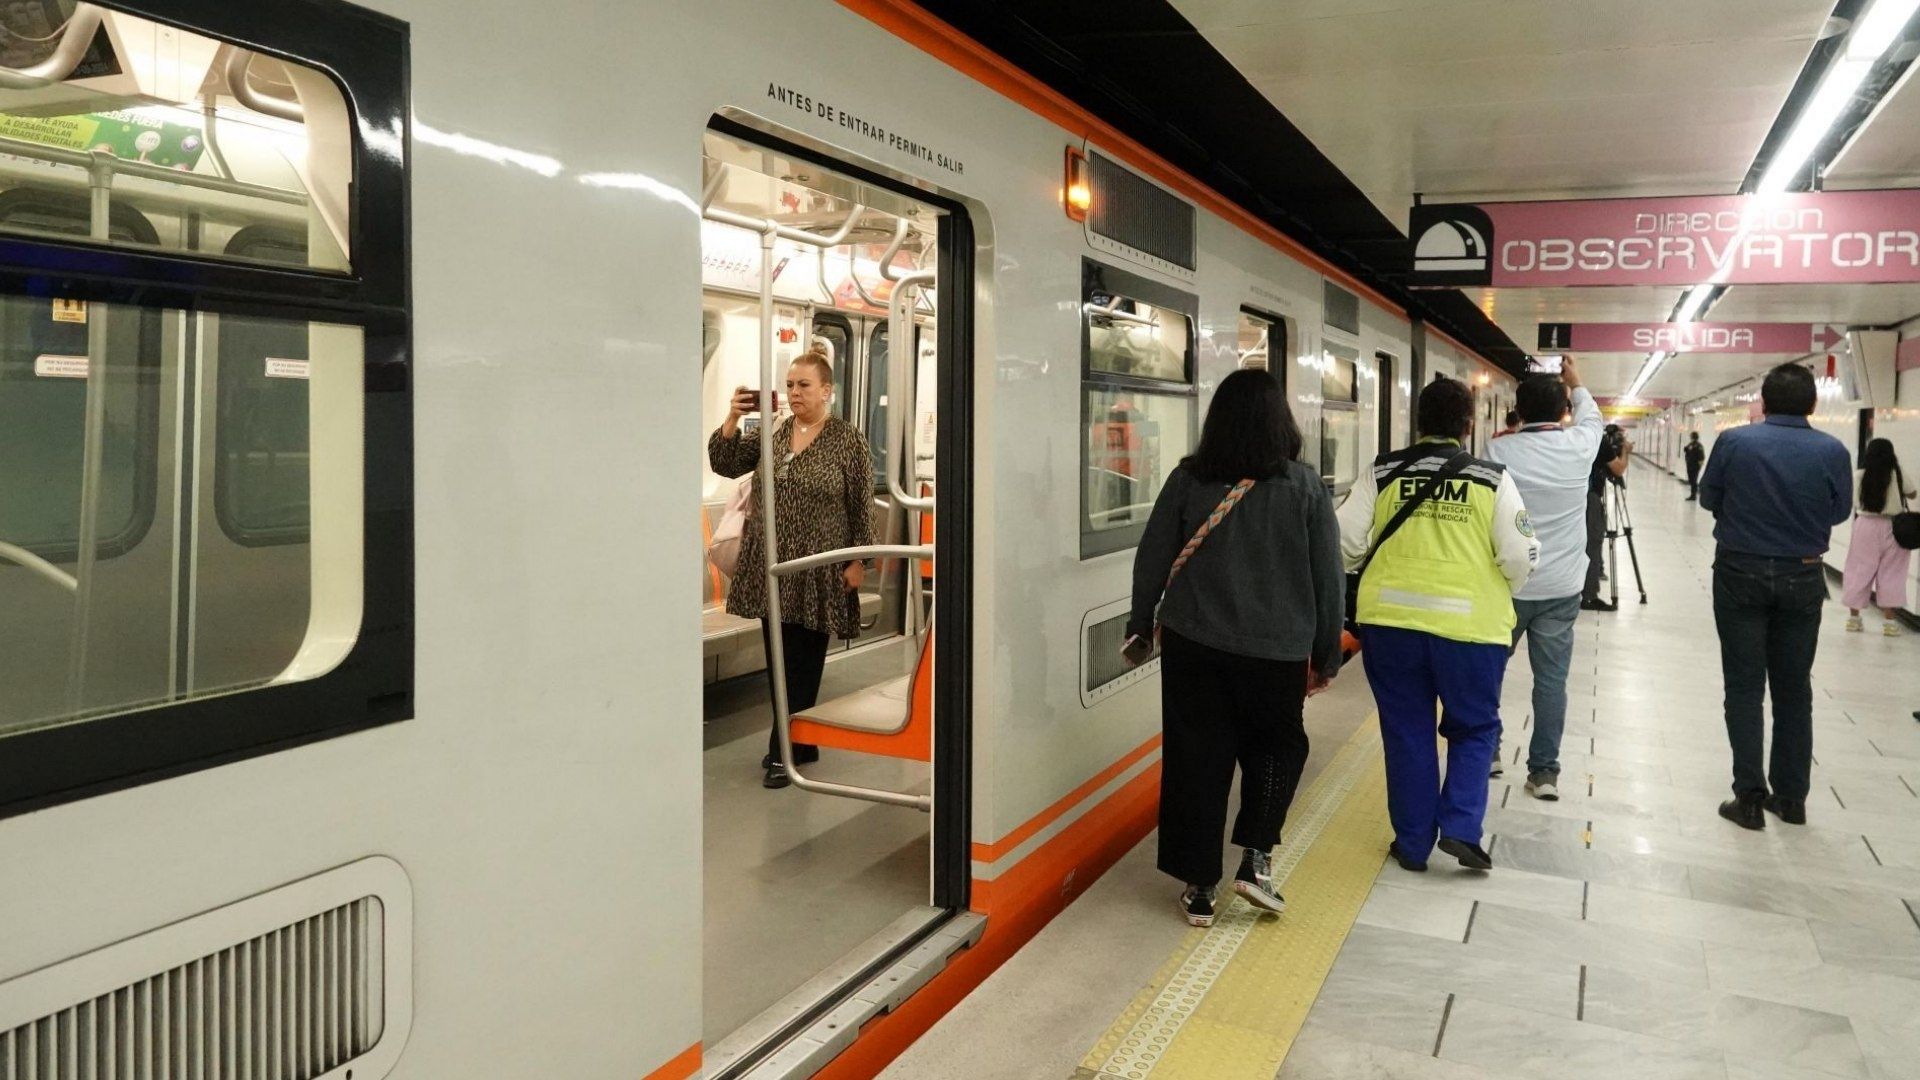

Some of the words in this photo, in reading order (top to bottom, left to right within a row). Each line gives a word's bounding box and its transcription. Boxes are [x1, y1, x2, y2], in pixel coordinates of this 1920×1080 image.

[13, 120, 72, 138] DESARROLLAR
[52, 119, 79, 130] AYUDA
[767, 82, 812, 113] ANTES
[817, 102, 834, 122] DE
[839, 111, 885, 143] ENTRAR
[889, 133, 933, 162] PERMITA
[937, 153, 964, 175] SALIR
[42, 135, 84, 149] DIGITALES
[1502, 231, 1919, 272] OBSERVATOR
[1633, 328, 1753, 348] SALIDA
[1438, 513, 1469, 524] MEDICAS
[1441, 505, 1473, 516] RESCATE
